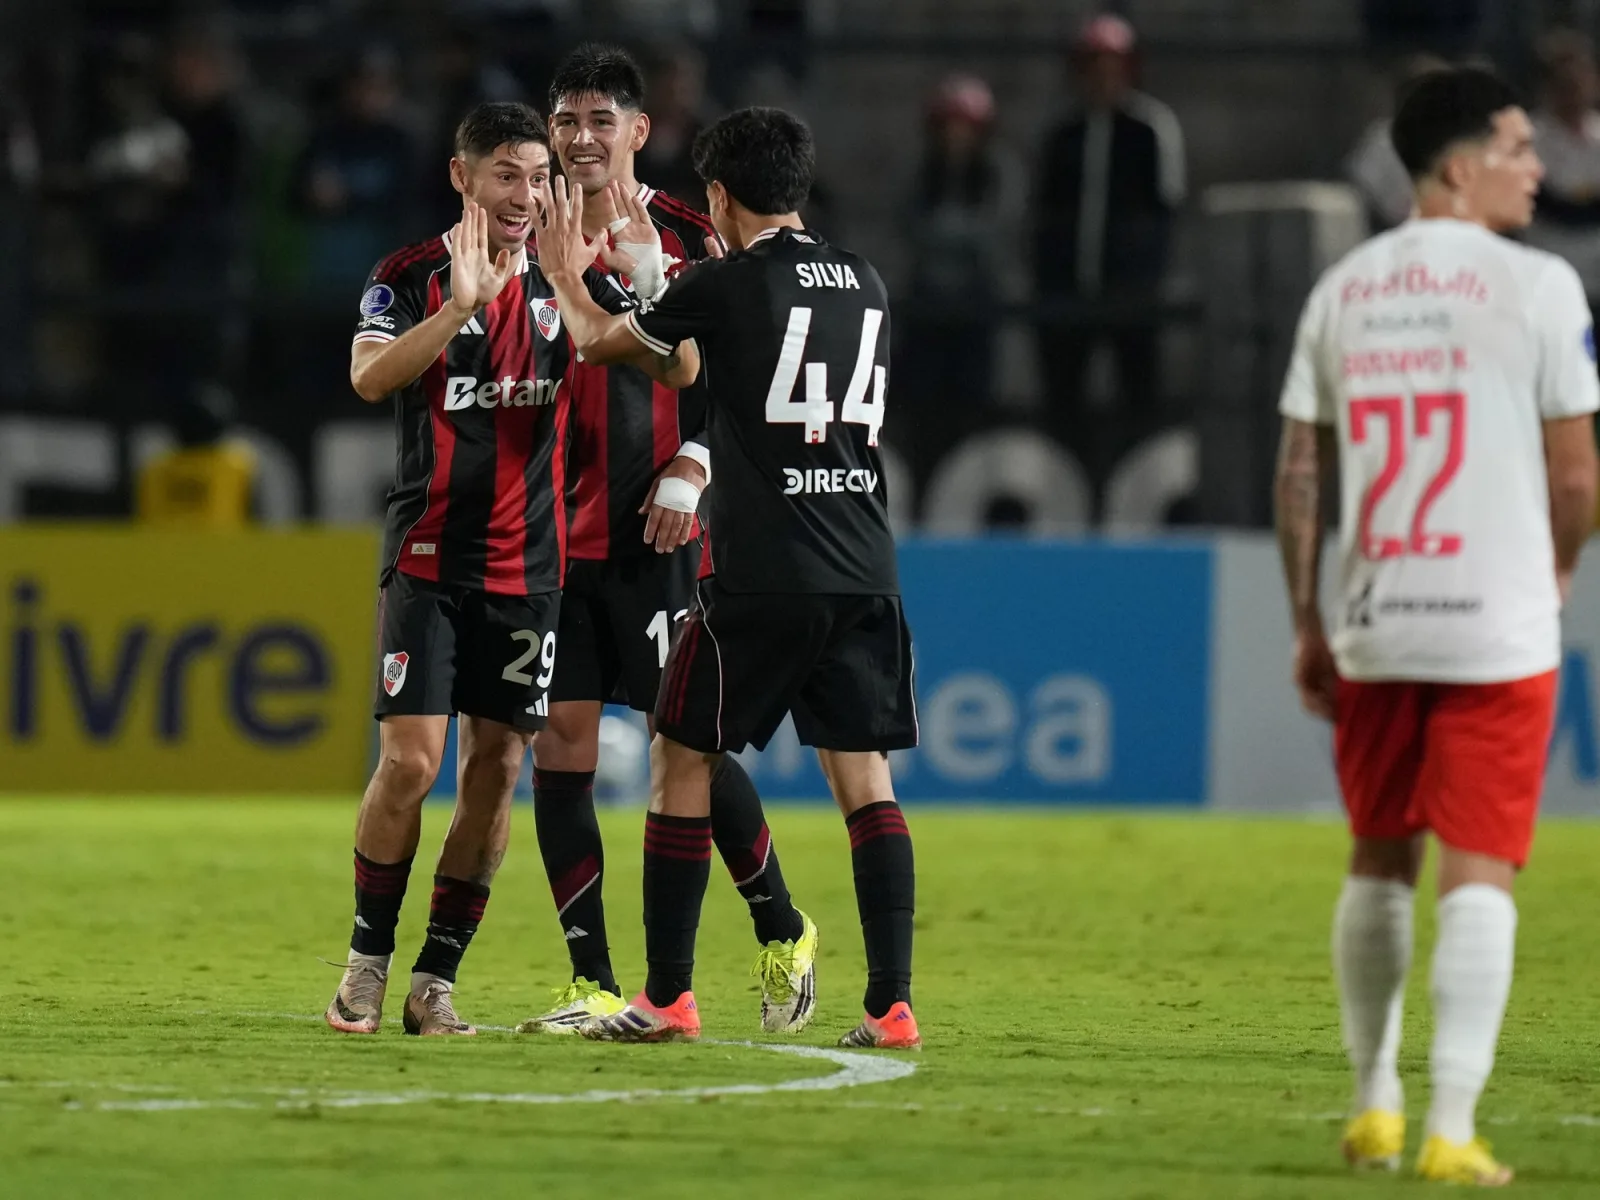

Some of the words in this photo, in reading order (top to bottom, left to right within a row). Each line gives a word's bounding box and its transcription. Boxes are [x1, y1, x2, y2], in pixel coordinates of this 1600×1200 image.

[795, 262, 860, 289] SILVA
[765, 306, 885, 447] 44
[1348, 392, 1467, 560] 22
[12, 575, 330, 746] ivre
[501, 629, 556, 688] 29
